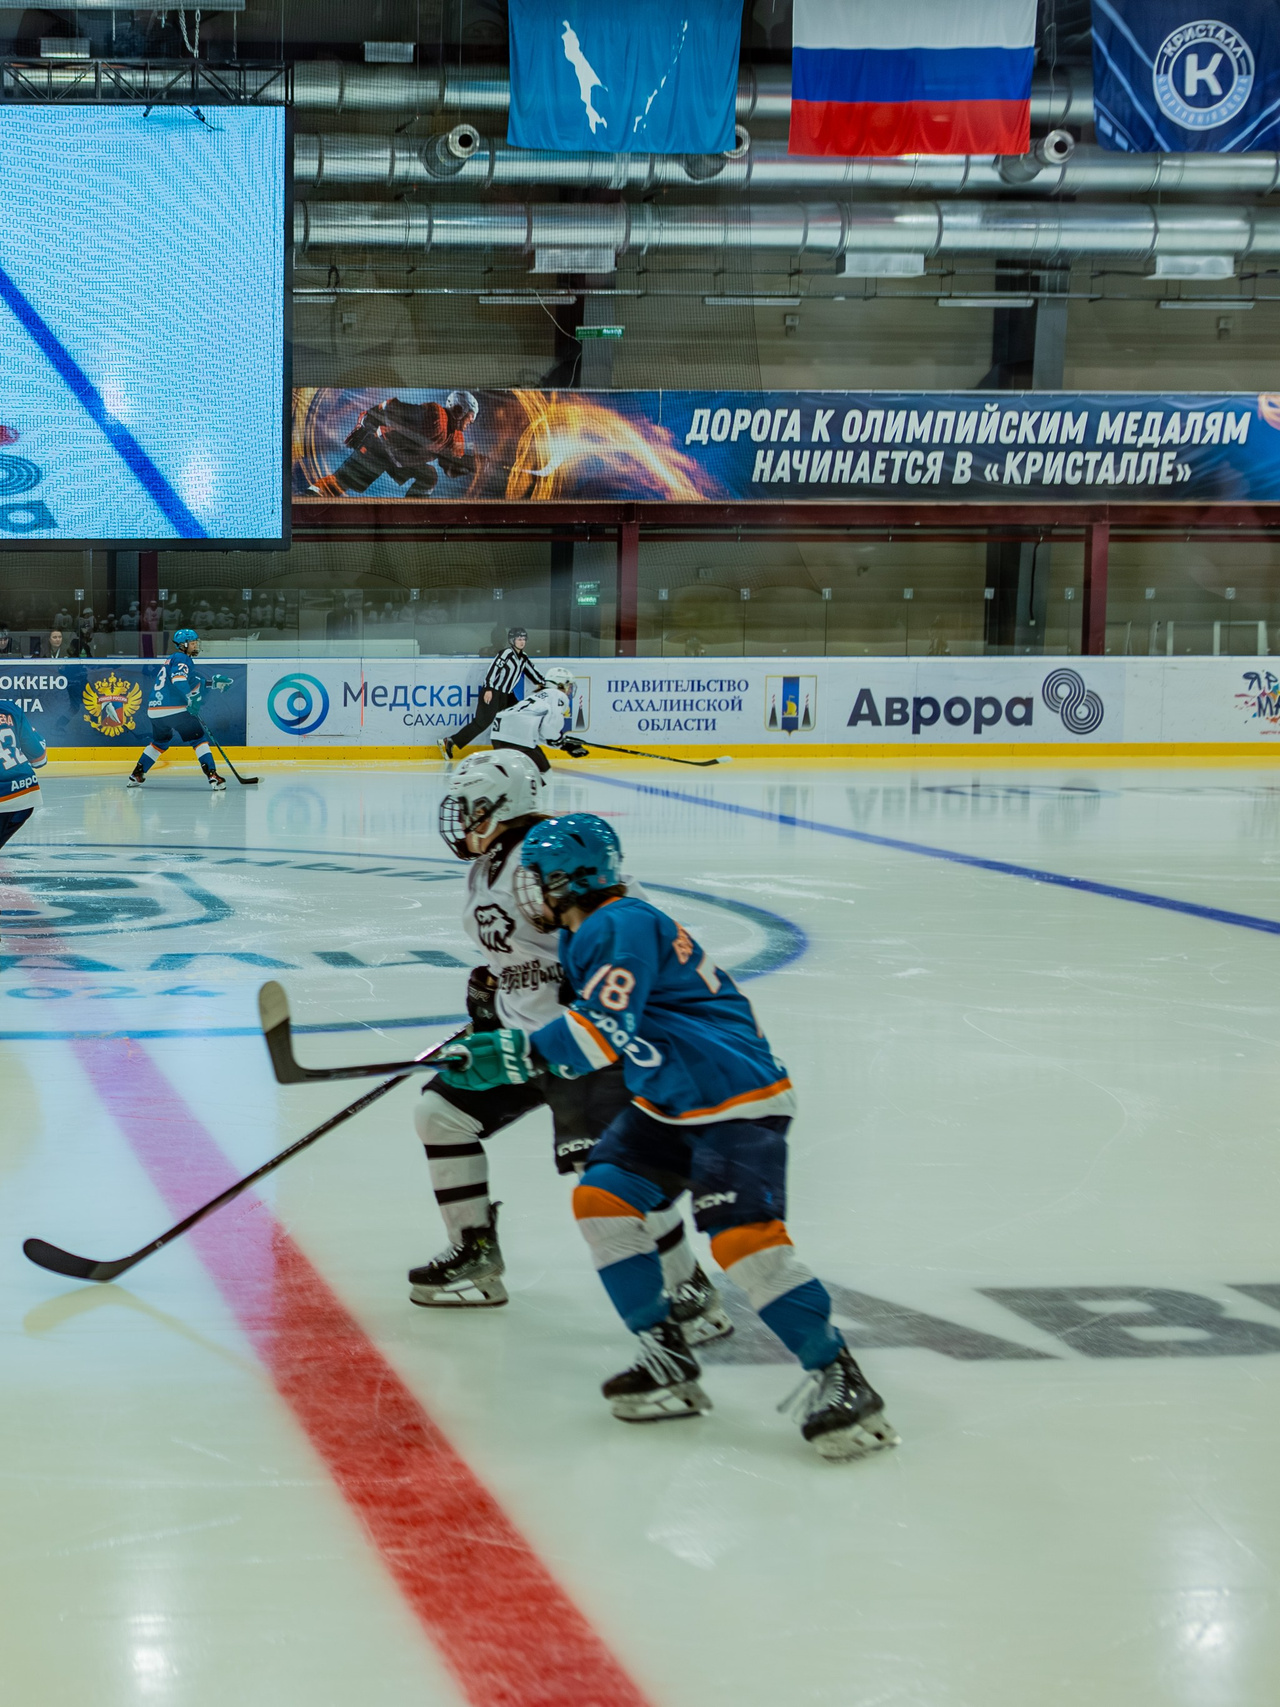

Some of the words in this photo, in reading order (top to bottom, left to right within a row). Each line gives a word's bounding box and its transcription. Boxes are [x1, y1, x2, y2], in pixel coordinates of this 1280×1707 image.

[1162, 24, 1245, 58] КРИСТАЛЛ
[685, 408, 801, 444] ДОРОГА
[811, 409, 832, 444] К
[842, 404, 1086, 445] ОЛИМПИЙСКИМ
[1096, 411, 1251, 445] МЕДАЛЯМ
[751, 450, 945, 484] НАЧИНАЕТСЯ
[951, 450, 972, 484] В
[984, 450, 1193, 485] «КРИСТАЛЛЕ»
[343, 682, 483, 711] Медскан
[607, 679, 749, 692] ПРАВИТЕЛЬСТВО
[612, 695, 743, 712] САХАЛИНСКОЙ
[847, 688, 1034, 734] Аврора
[403, 714, 475, 726] САХАЛИ
[637, 718, 717, 731] ОБЛАСТИ
